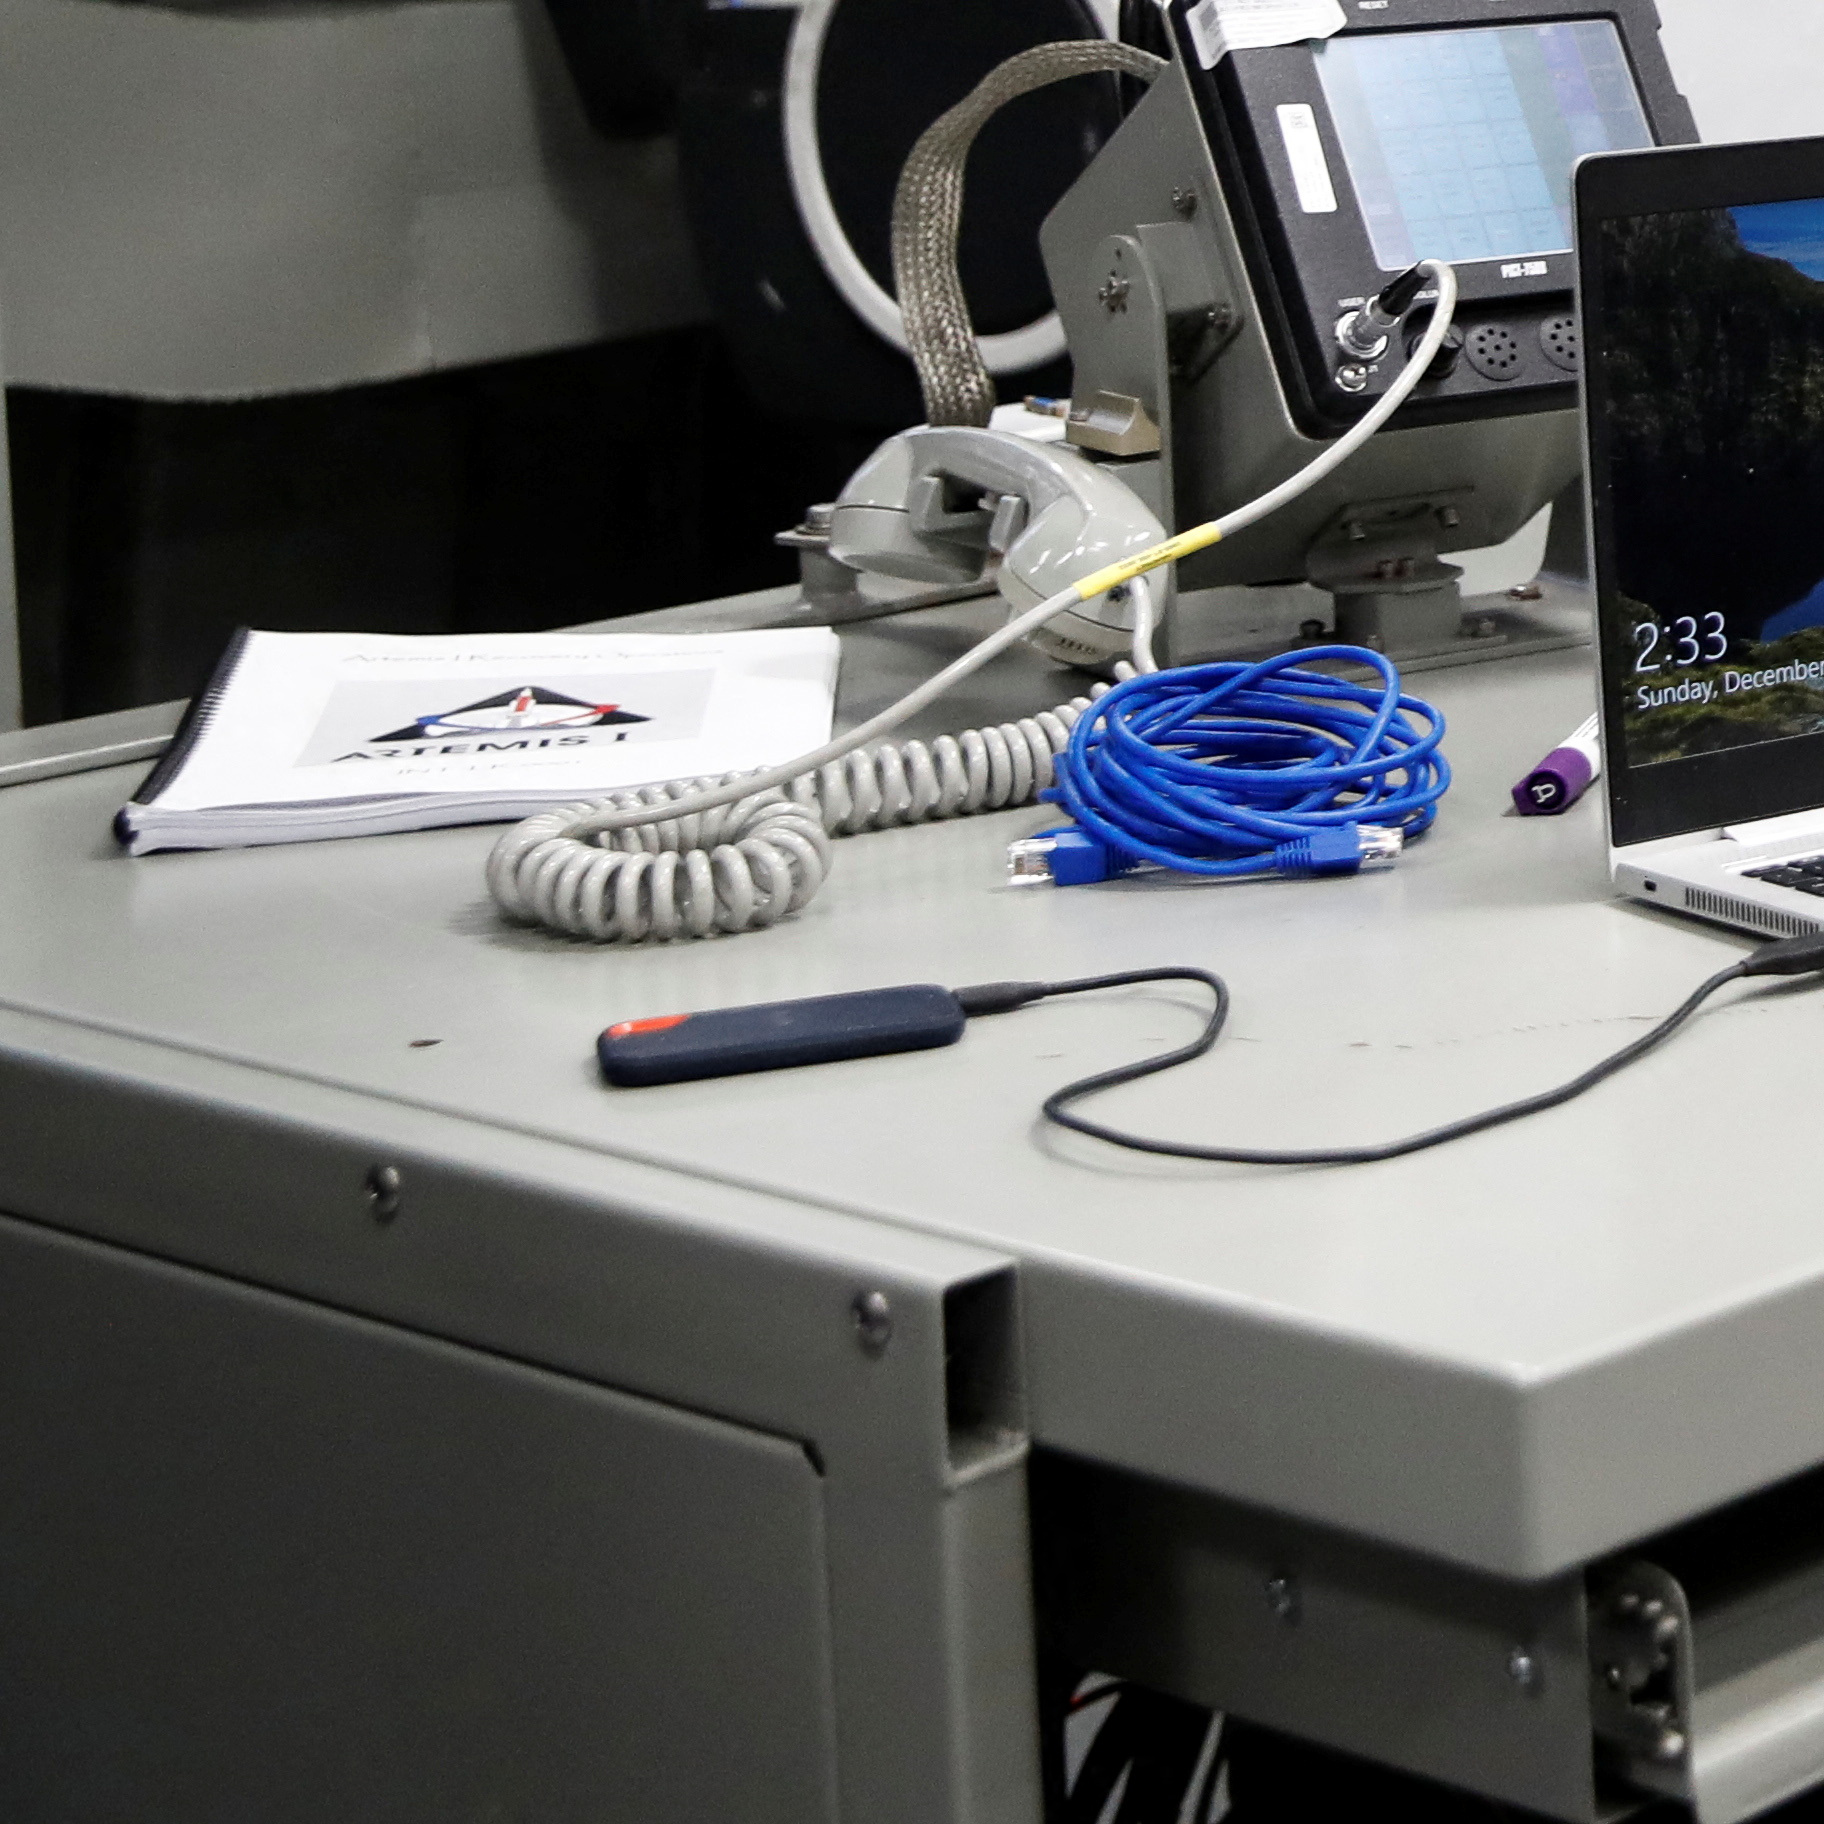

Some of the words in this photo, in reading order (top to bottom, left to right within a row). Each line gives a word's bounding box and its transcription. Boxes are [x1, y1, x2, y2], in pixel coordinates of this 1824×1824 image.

[1635, 611, 1728, 672] 2:33
[1637, 678, 1718, 709] Sunday,
[330, 734, 591, 763] ARTEMIS
[615, 731, 629, 743] I
